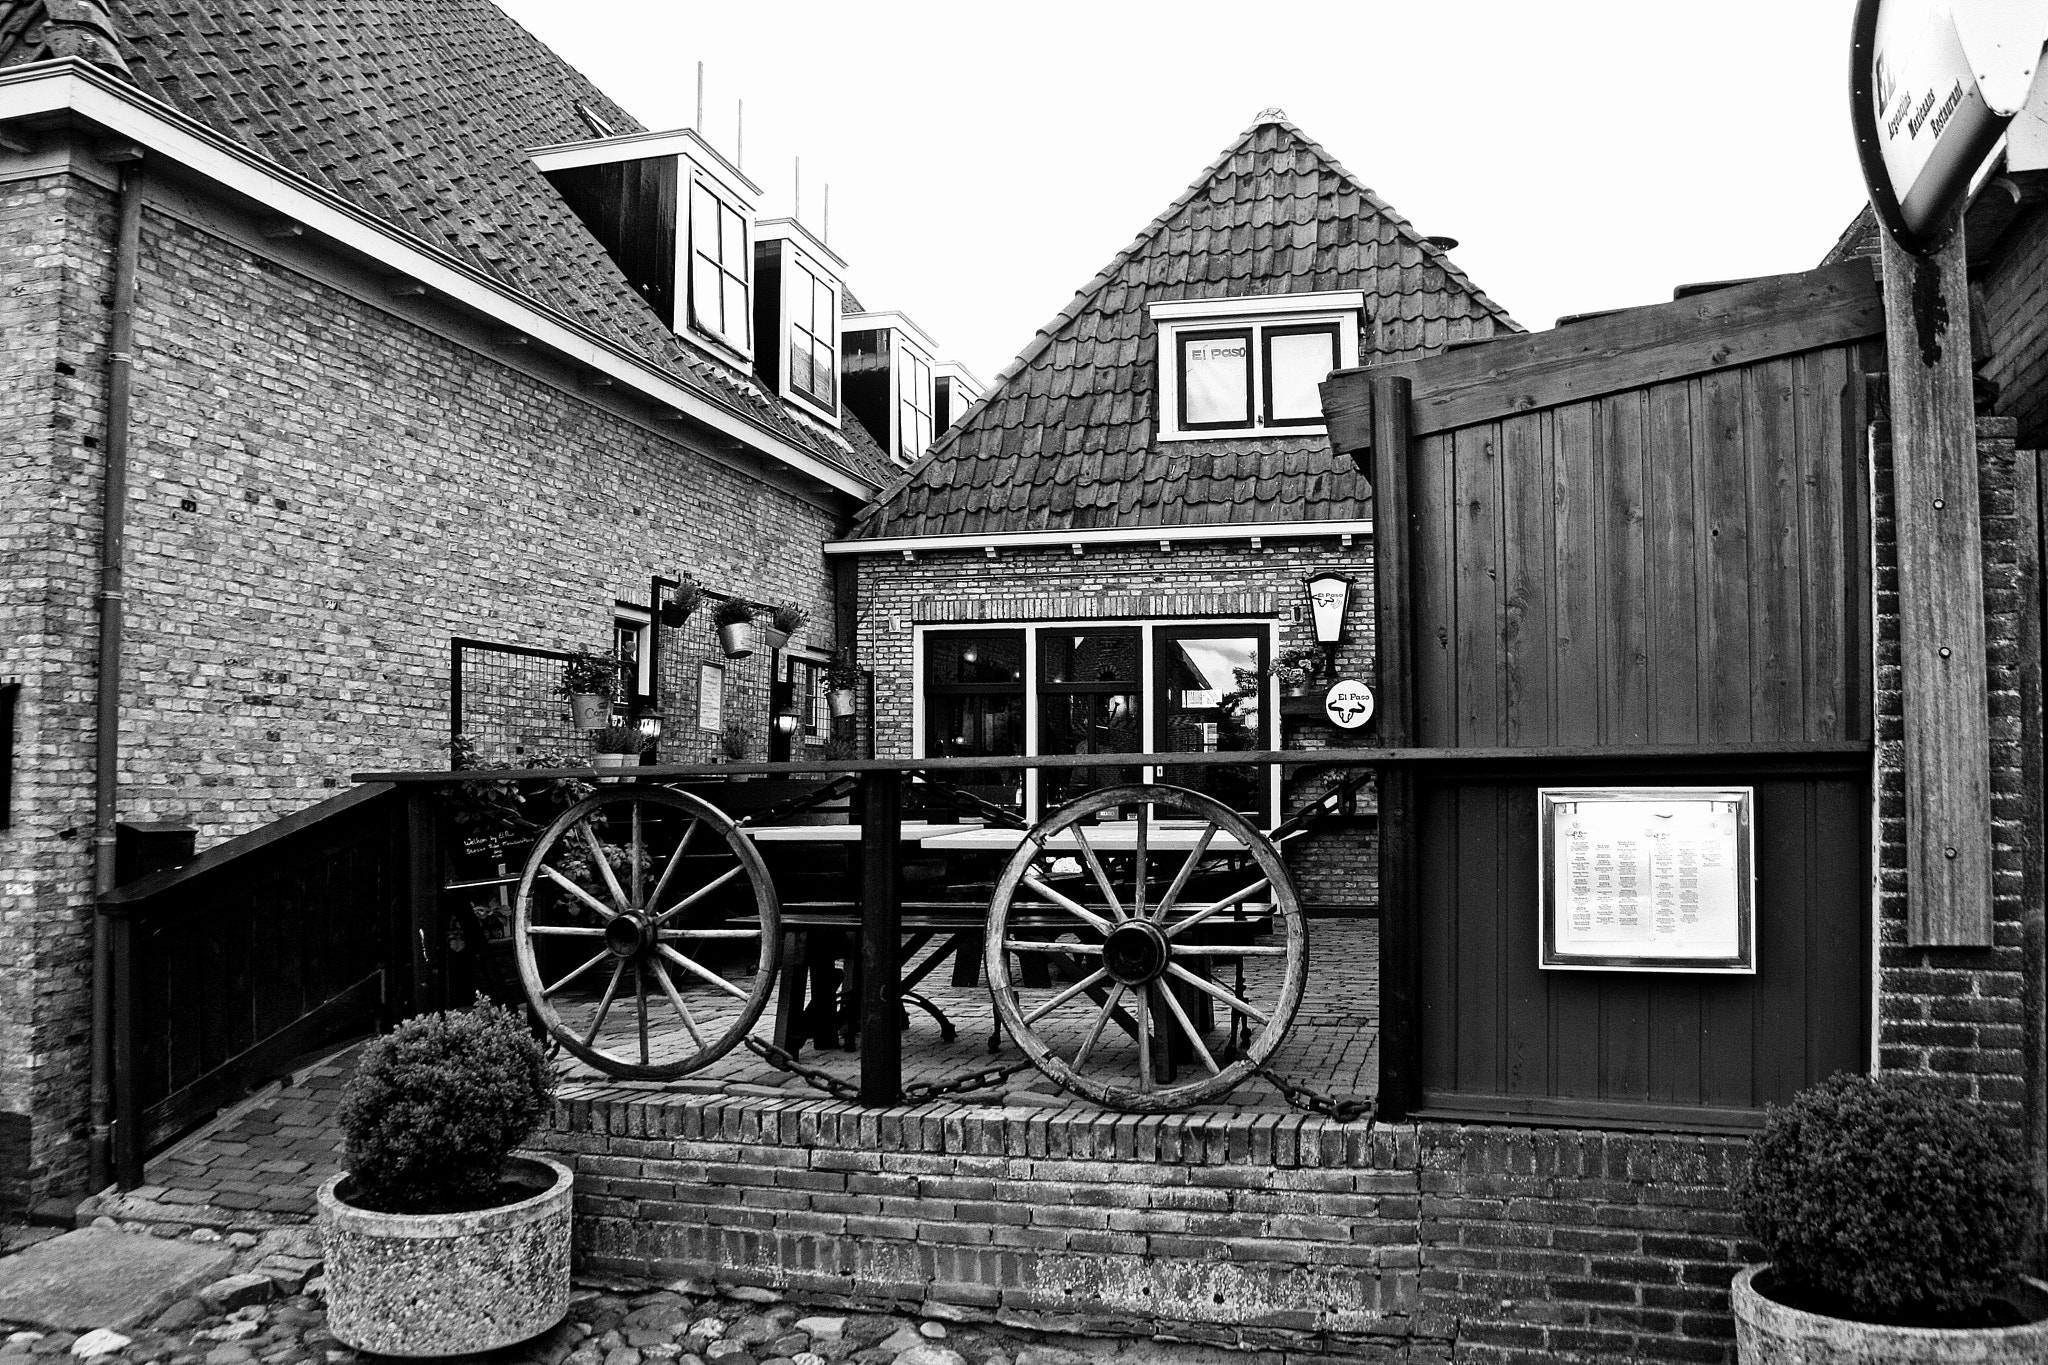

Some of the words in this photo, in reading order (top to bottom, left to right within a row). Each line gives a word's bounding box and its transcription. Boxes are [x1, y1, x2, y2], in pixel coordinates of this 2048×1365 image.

[1930, 76, 1964, 140] Restaurant
[1338, 693, 1347, 701] El
[1350, 693, 1370, 701] Paso
